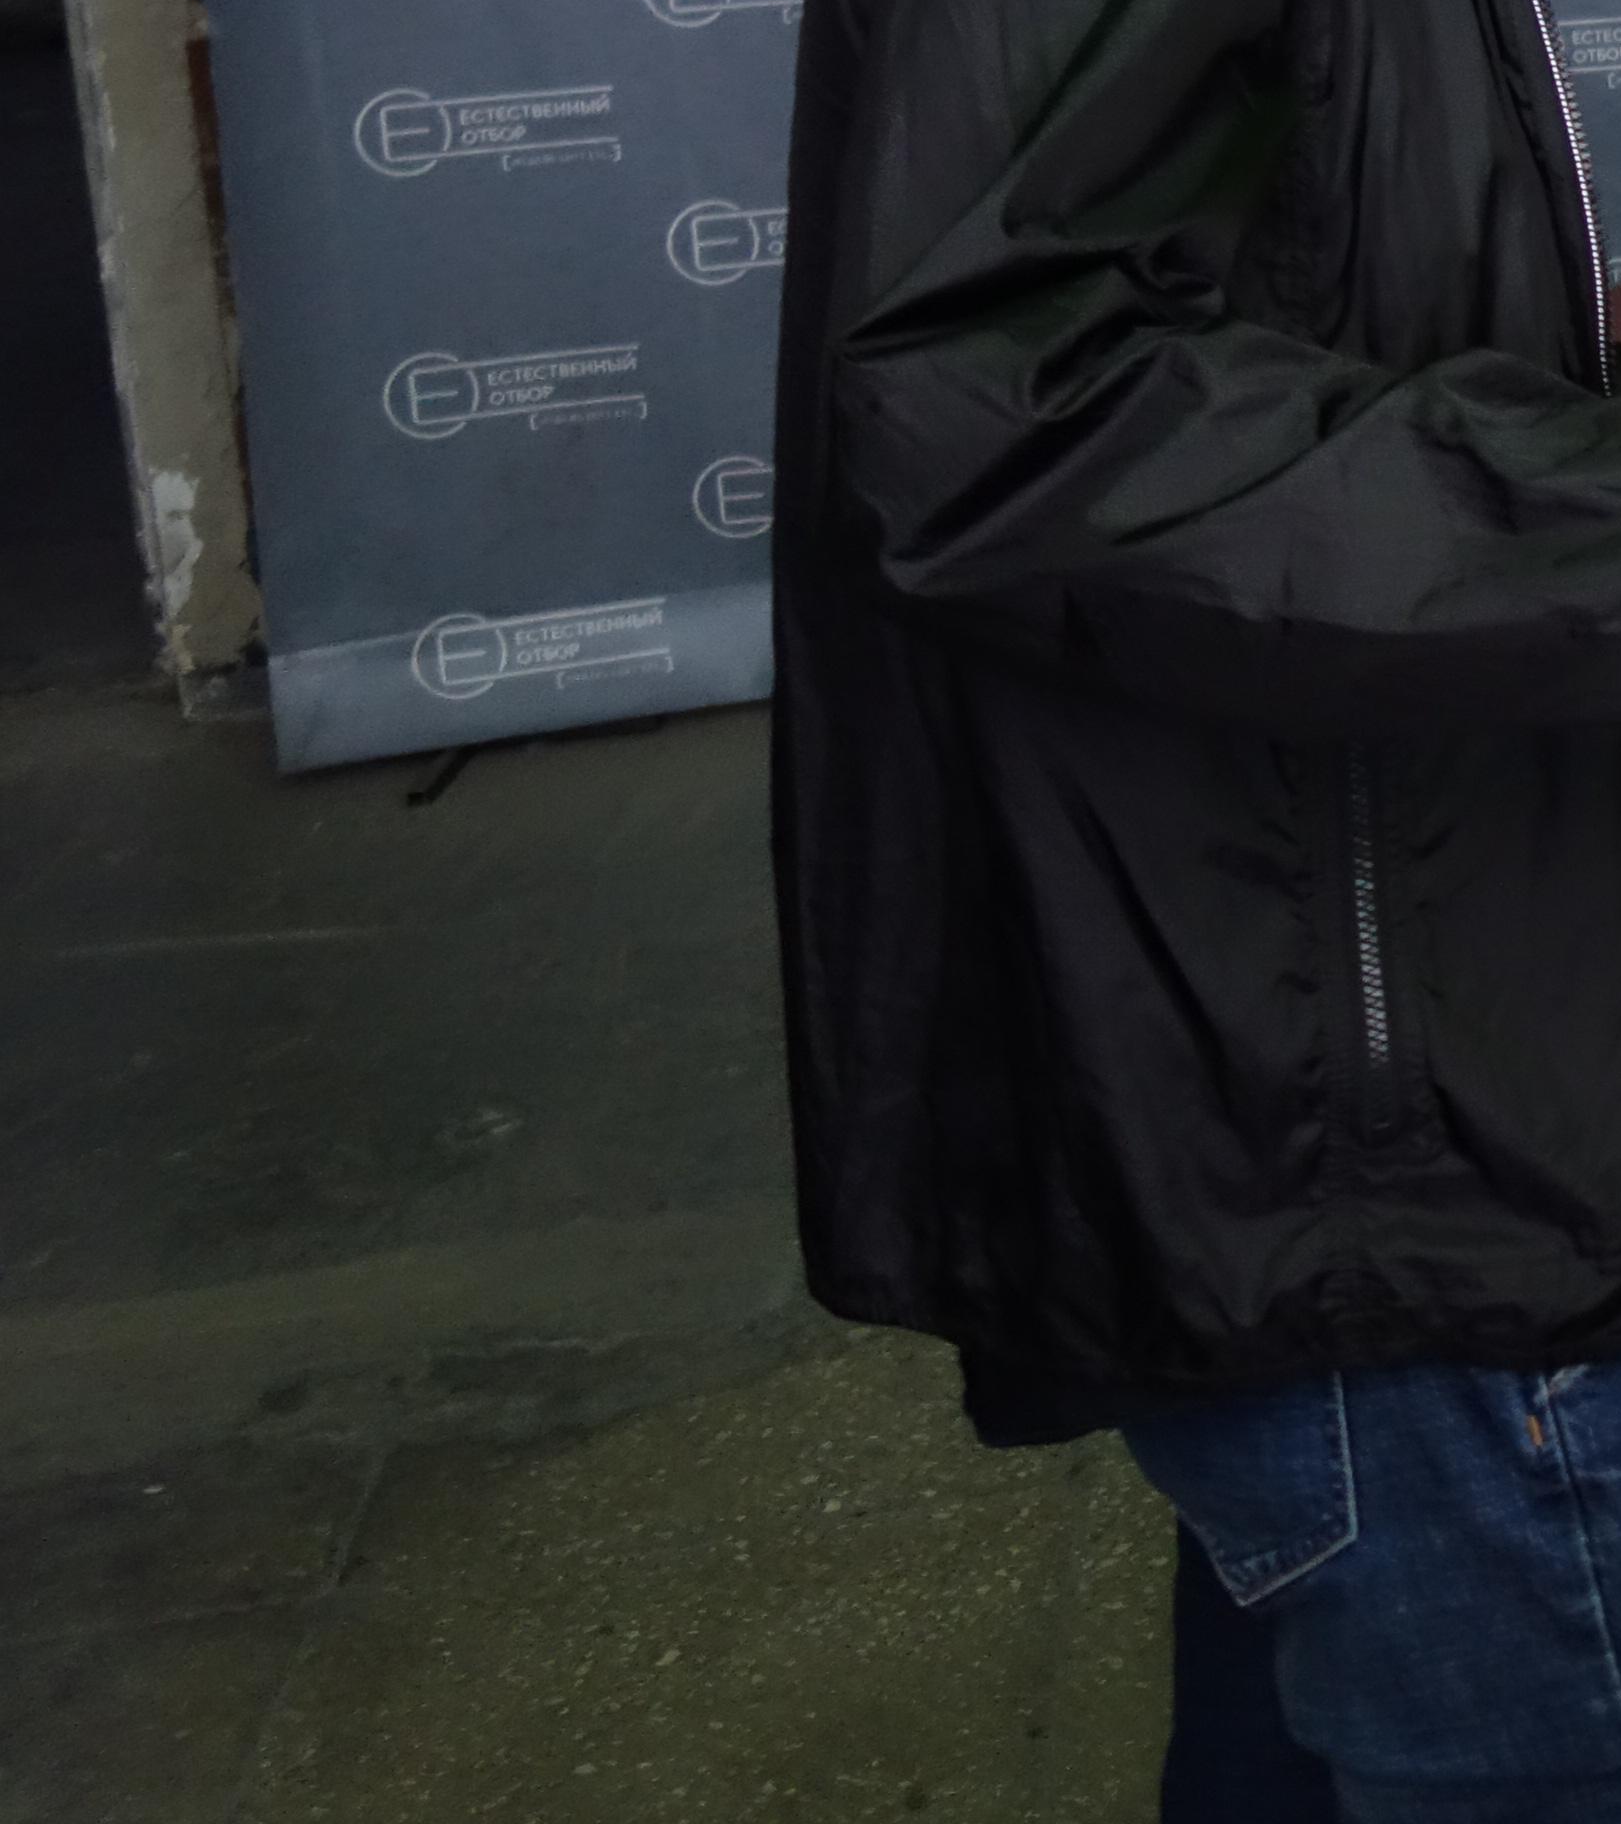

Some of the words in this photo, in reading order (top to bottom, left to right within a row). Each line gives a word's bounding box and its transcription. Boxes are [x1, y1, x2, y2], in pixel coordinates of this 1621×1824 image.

[460, 94, 611, 126] ЕСТЕСТВЕННЫЙ
[461, 125, 528, 146] ОТБОР
[488, 351, 637, 388] ЕСТЕСТВЕННЫЙ
[489, 385, 555, 407] ОТБОР
[513, 607, 664, 646] ЕСТЕСТВЕННЫЙ
[515, 643, 582, 667] ОТБОР
